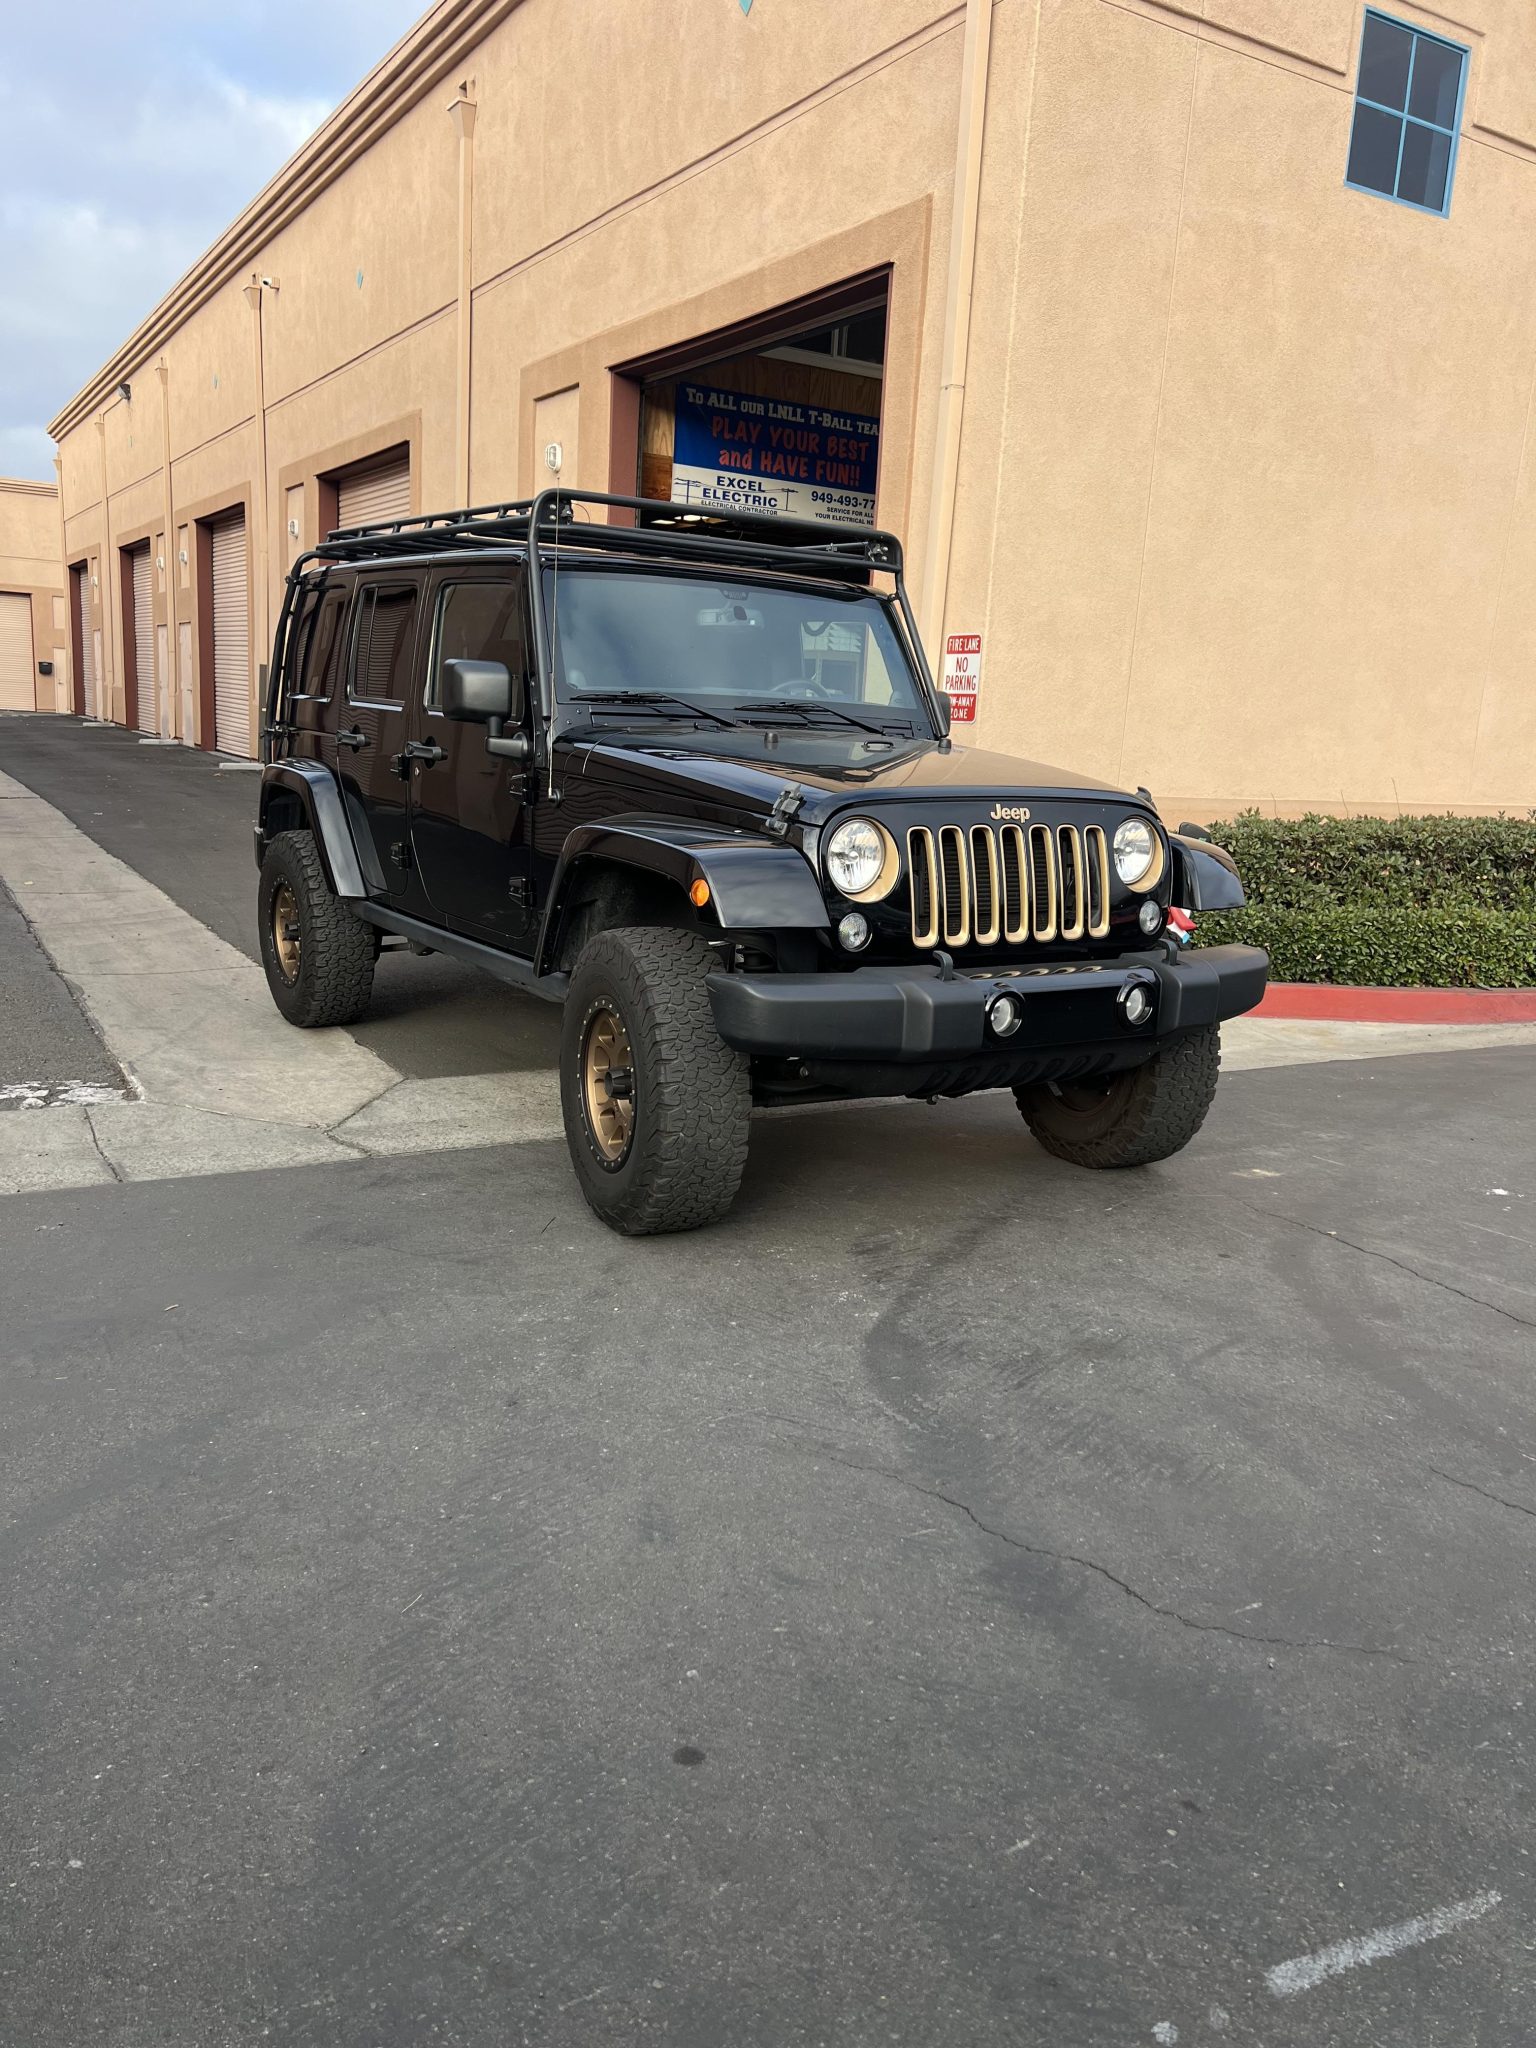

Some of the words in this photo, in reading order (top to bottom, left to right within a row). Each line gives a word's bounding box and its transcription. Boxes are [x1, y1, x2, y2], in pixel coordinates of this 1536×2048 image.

[707, 392, 737, 411] ALL
[768, 403, 805, 423] LNLL
[711, 415, 762, 444] PLAY
[769, 425, 820, 455] YOUR
[827, 435, 869, 462] BEST
[719, 448, 753, 470] and
[760, 450, 808, 478] HAVE
[815, 460, 860, 487] FUN!!
[716, 475, 766, 493] EXCEL
[702, 487, 778, 508] ELECTRIC
[701, 499, 737, 511] ELECTRICAL
[738, 505, 778, 516] CONTRACTOR
[826, 506, 851, 515] SERVICE
[832, 515, 866, 525] ELECTRICAL
[948, 638, 963, 651] FIRE
[964, 638, 979, 651] LANE
[956, 656, 969, 673] NO
[945, 674, 977, 691] PARKING
[990, 803, 1031, 823] Jeep
